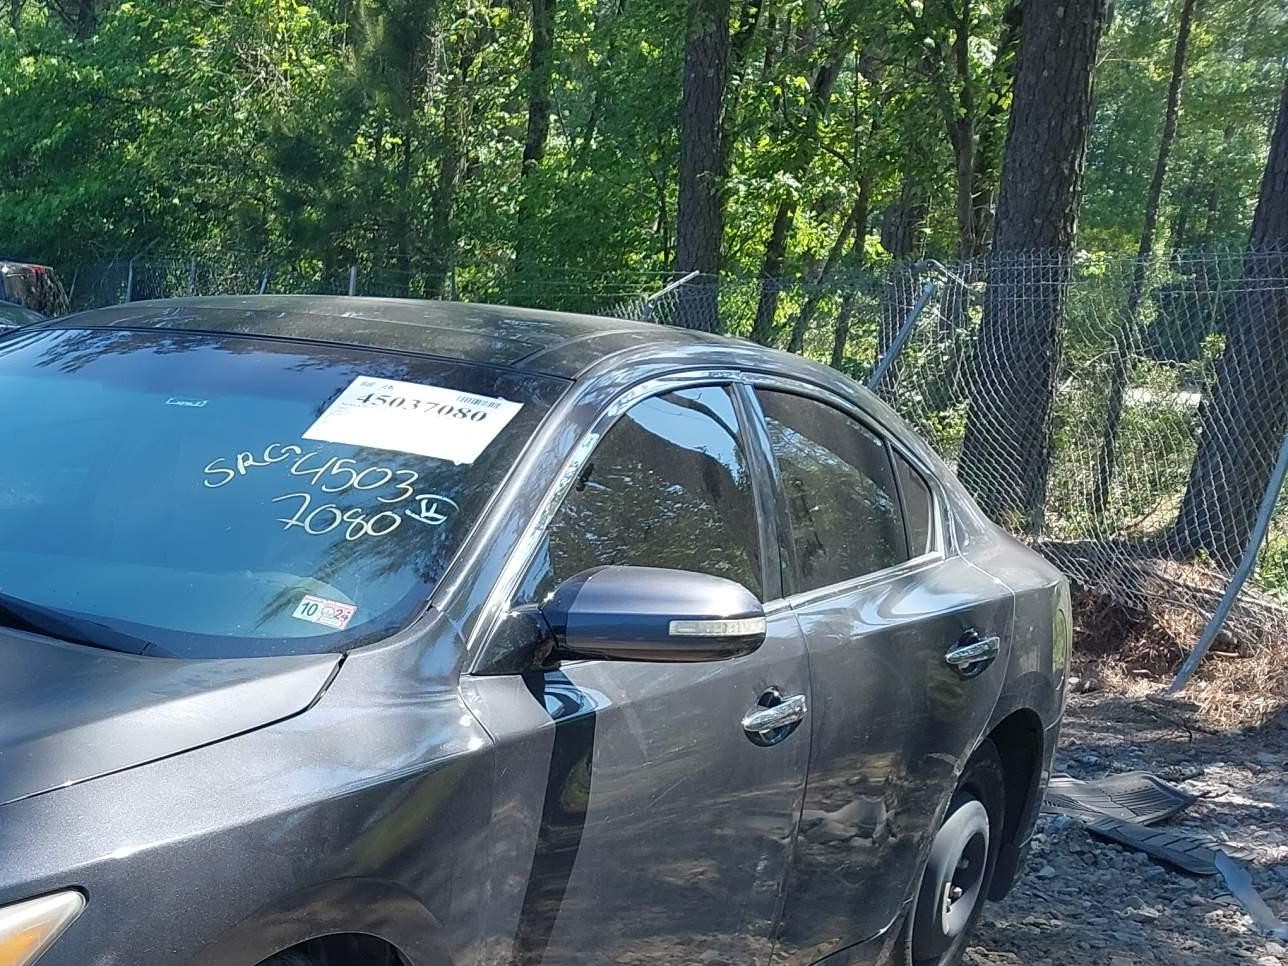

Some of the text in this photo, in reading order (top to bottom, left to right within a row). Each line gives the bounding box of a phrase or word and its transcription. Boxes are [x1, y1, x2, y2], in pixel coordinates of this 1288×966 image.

[356, 392, 488, 422] 45037080
[291, 451, 419, 503] 4503
[272, 493, 402, 541] 7080
[300, 602, 319, 616] 10
